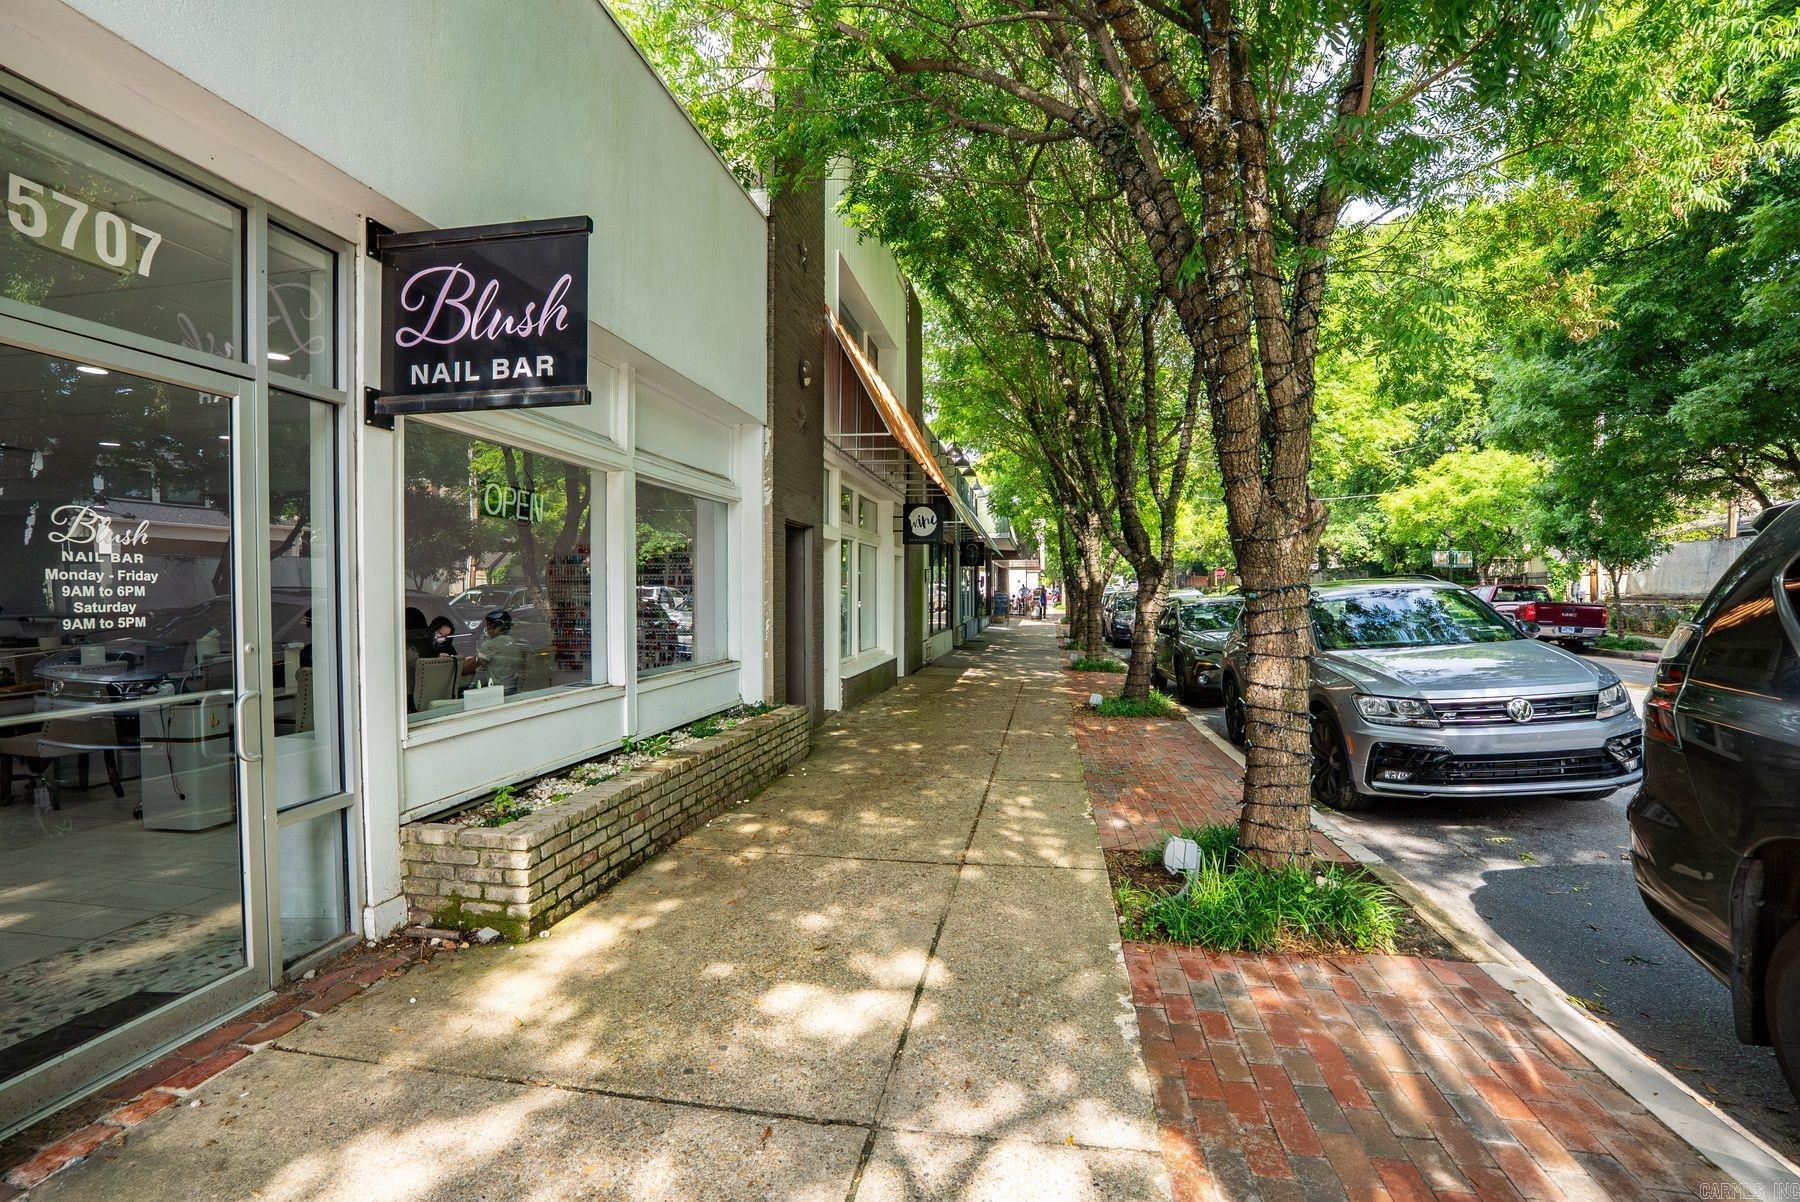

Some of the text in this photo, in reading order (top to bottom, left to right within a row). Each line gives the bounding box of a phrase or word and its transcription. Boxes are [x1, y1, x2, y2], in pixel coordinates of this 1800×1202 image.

[8, 173, 162, 277] 5707
[395, 262, 572, 348] Blush
[411, 355, 554, 386] NAIL BAR
[484, 483, 544, 522] OPEN
[48, 505, 150, 546] Blush
[61, 551, 144, 564] NAIL BAR
[44, 568, 105, 583] Monday
[117, 569, 159, 584] Friday
[61, 585, 146, 597] 9AM to 6PM
[73, 601, 137, 614] Saturday
[62, 616, 147, 630] 9AM to 5PM
